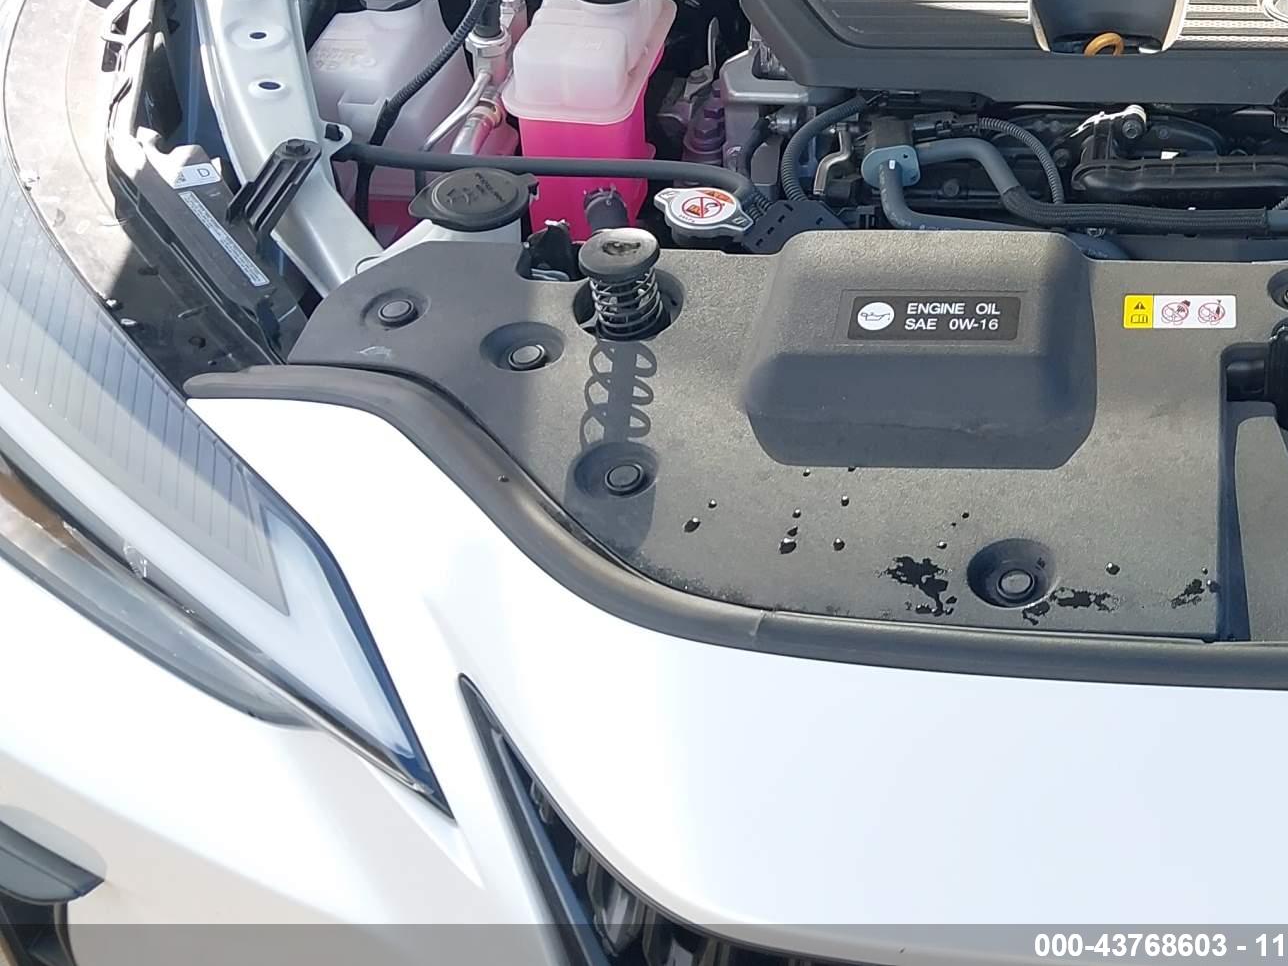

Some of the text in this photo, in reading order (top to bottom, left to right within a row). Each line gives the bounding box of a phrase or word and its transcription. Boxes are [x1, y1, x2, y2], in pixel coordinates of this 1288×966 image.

[906, 302, 1001, 315] ENGINE OIL
[904, 317, 999, 331] SAE 0W-16
